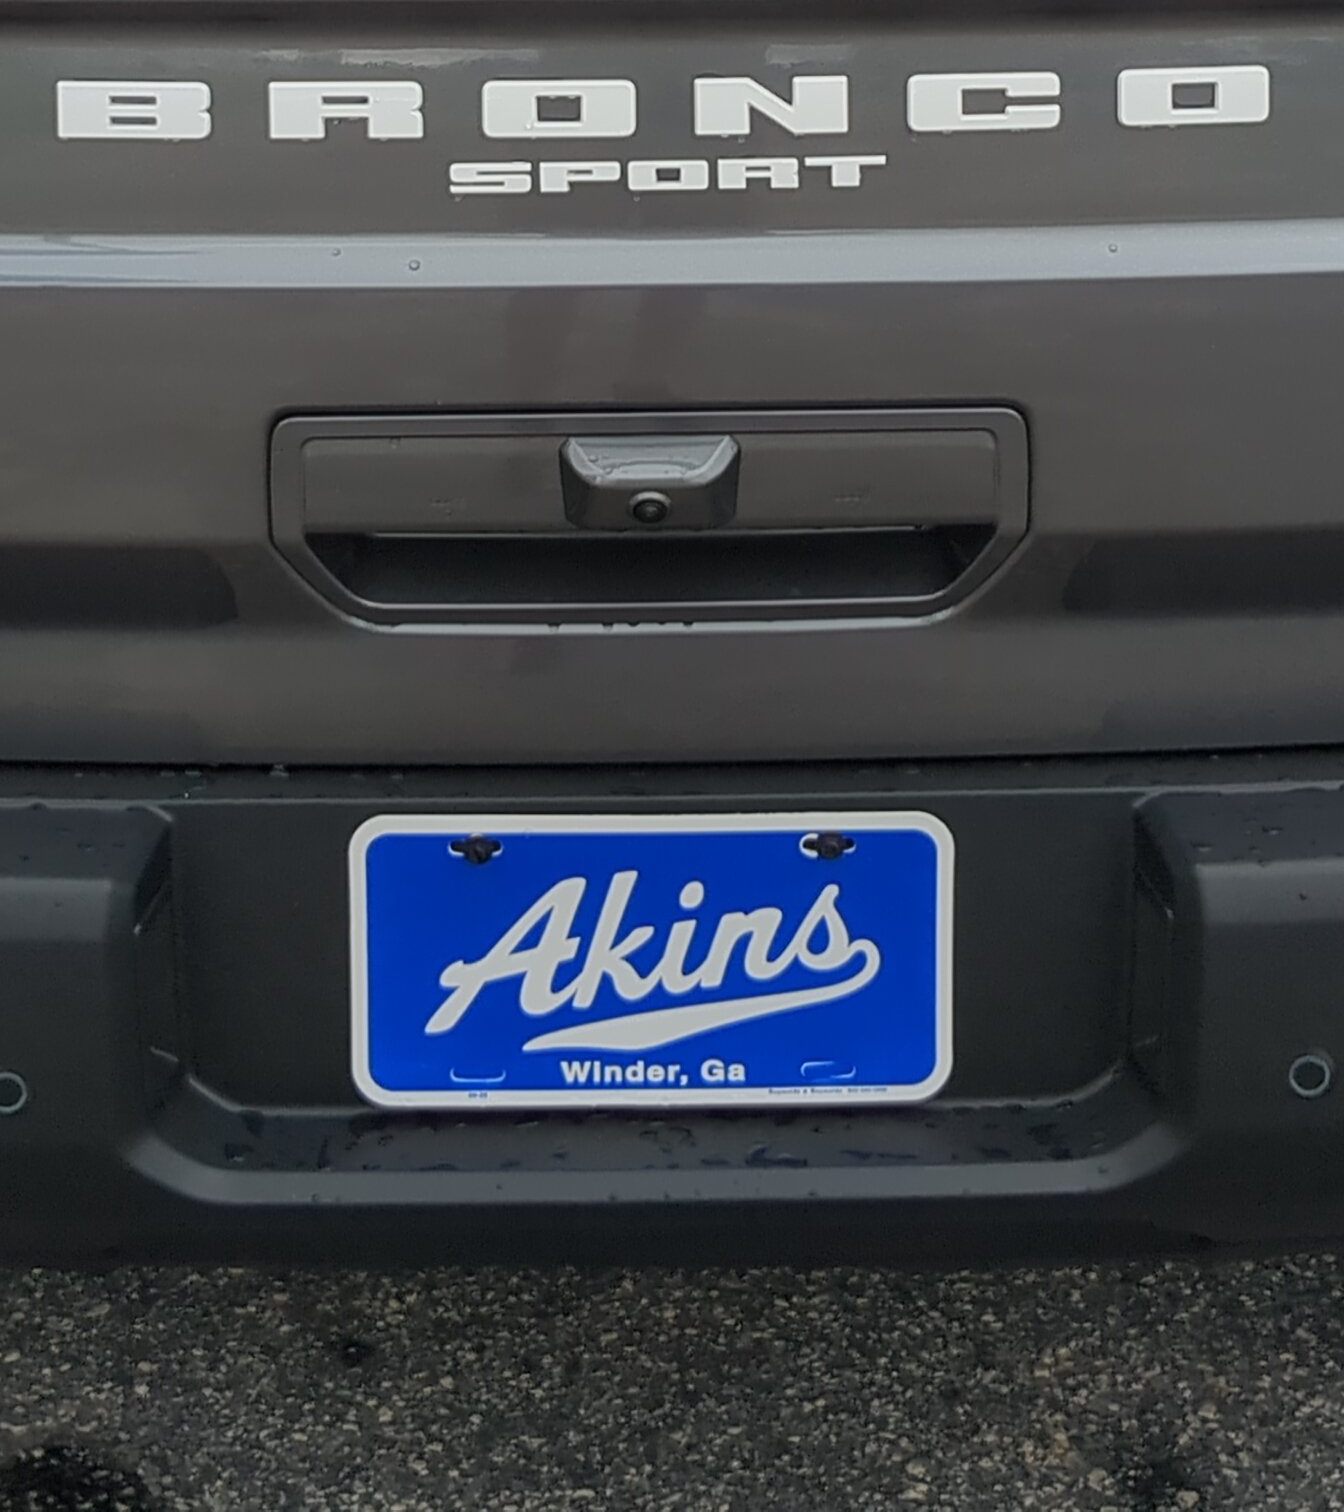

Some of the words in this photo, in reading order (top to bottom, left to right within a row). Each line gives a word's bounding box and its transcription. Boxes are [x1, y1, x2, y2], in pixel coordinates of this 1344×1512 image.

[55, 65, 1272, 140] BRONCO
[448, 153, 888, 195] SPORT
[424, 870, 881, 1051] Akins
[560, 1060, 689, 1087] Winder,
[700, 1060, 747, 1083] Ga
